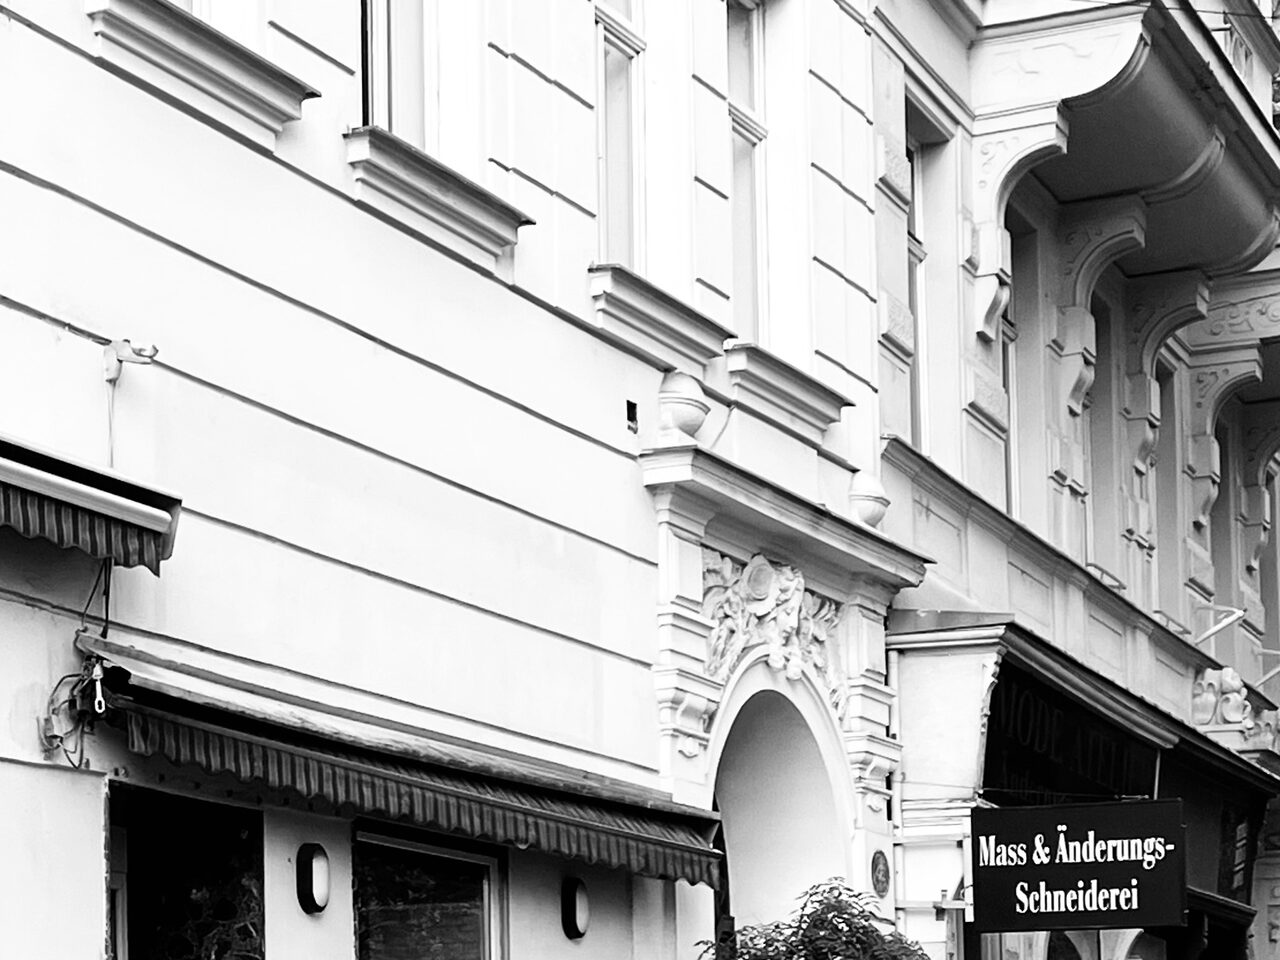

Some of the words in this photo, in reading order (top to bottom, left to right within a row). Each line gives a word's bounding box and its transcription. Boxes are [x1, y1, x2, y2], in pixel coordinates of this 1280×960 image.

[978, 835, 1027, 867] Mass
[1032, 833, 1051, 865] &
[1055, 824, 1175, 870] Änderungs-
[1015, 879, 1139, 914] Schneiderei
